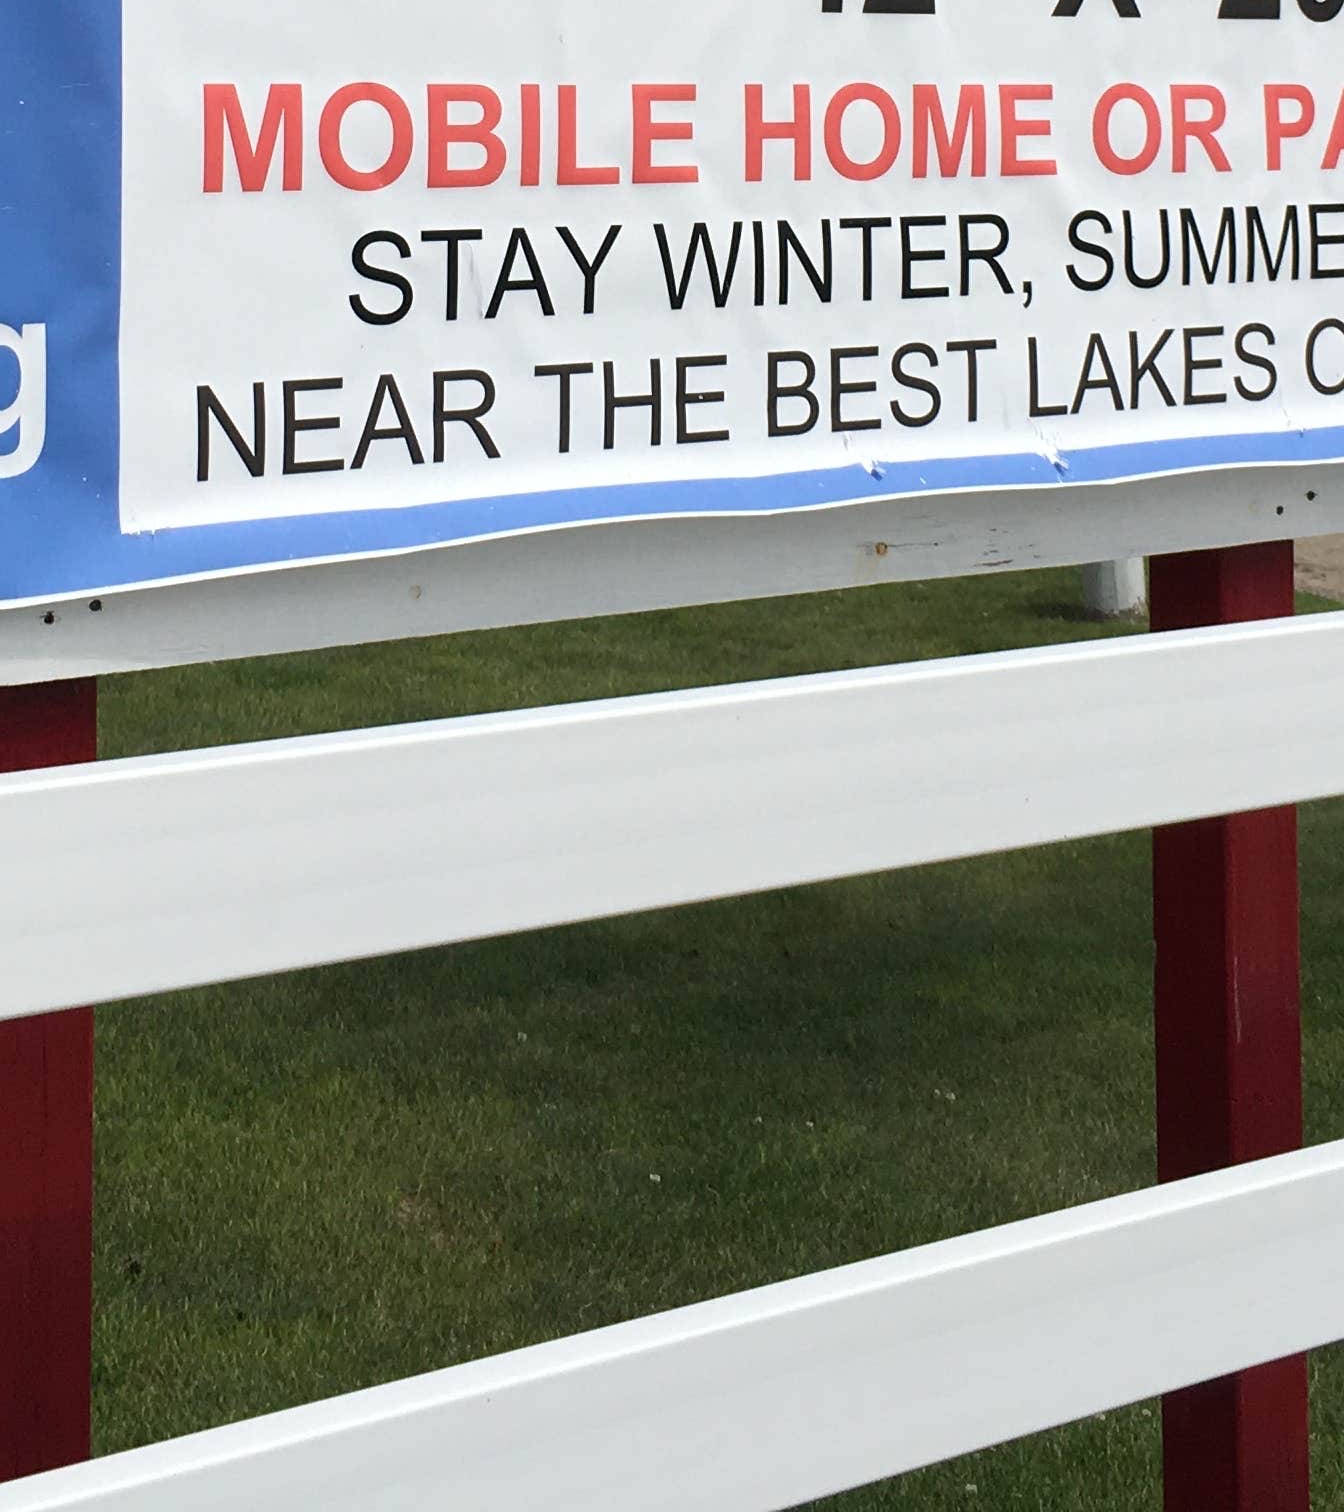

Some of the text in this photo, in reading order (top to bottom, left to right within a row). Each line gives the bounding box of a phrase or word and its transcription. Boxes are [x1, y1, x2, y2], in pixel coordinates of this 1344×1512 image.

[204, 83, 697, 192] MOBILE
[746, 83, 1056, 180] HOME
[1093, 84, 1229, 174] OR
[349, 225, 621, 325] STAY
[654, 213, 1033, 310] WINTER,
[197, 370, 500, 481] NEAR
[535, 355, 729, 453] THE
[768, 340, 996, 437] BEST
[1029, 323, 1276, 417] LAKES
